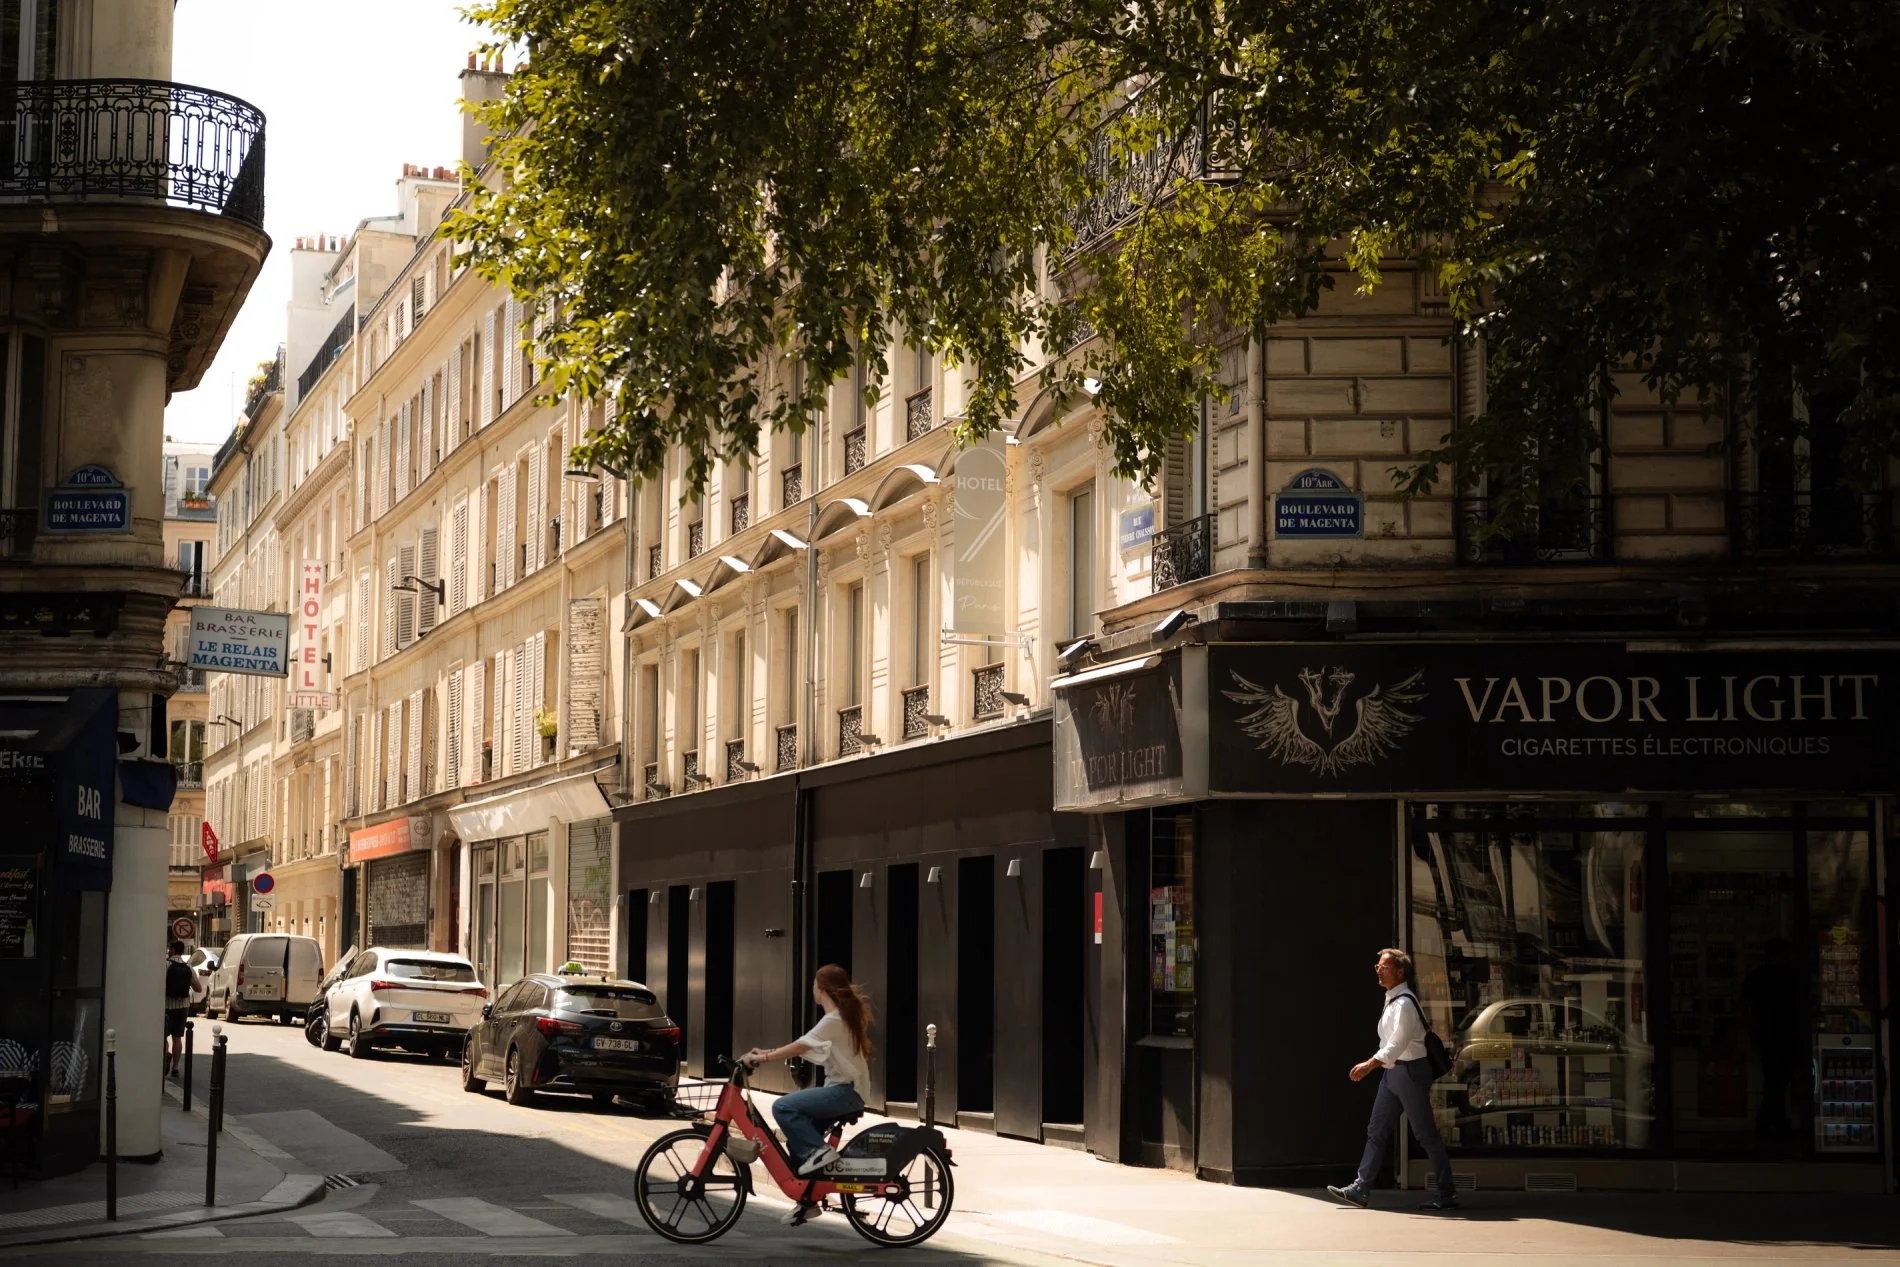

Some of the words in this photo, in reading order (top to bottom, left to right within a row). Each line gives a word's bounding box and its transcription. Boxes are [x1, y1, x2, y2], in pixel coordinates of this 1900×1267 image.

[957, 476, 1004, 492] HOTEL
[54, 500, 122, 510] BOULEVARD
[1281, 504, 1355, 515] BOULEVARD
[52, 513, 67, 524] DE
[70, 513, 121, 523] MAGENTA
[1279, 518, 1296, 528] DE
[1299, 518, 1356, 528] MAGENTA
[225, 613, 257, 625] BAR
[196, 622, 283, 639] BRASSERIE
[198, 641, 218, 652] LE
[222, 643, 278, 658] RELAIS
[192, 653, 281, 672] MAGENTA
[288, 695, 330, 707] LITTLE
[1453, 675, 1669, 723] VAPOR
[1684, 674, 1879, 723] LIGHT
[1501, 737, 1638, 757] CIGARETTES
[1643, 732, 1831, 758] ÉLECTRONIQUES
[1120, 744, 1167, 783] LIGHT
[78, 784, 102, 821] BAR
[68, 833, 107, 859] BRASSERIE
